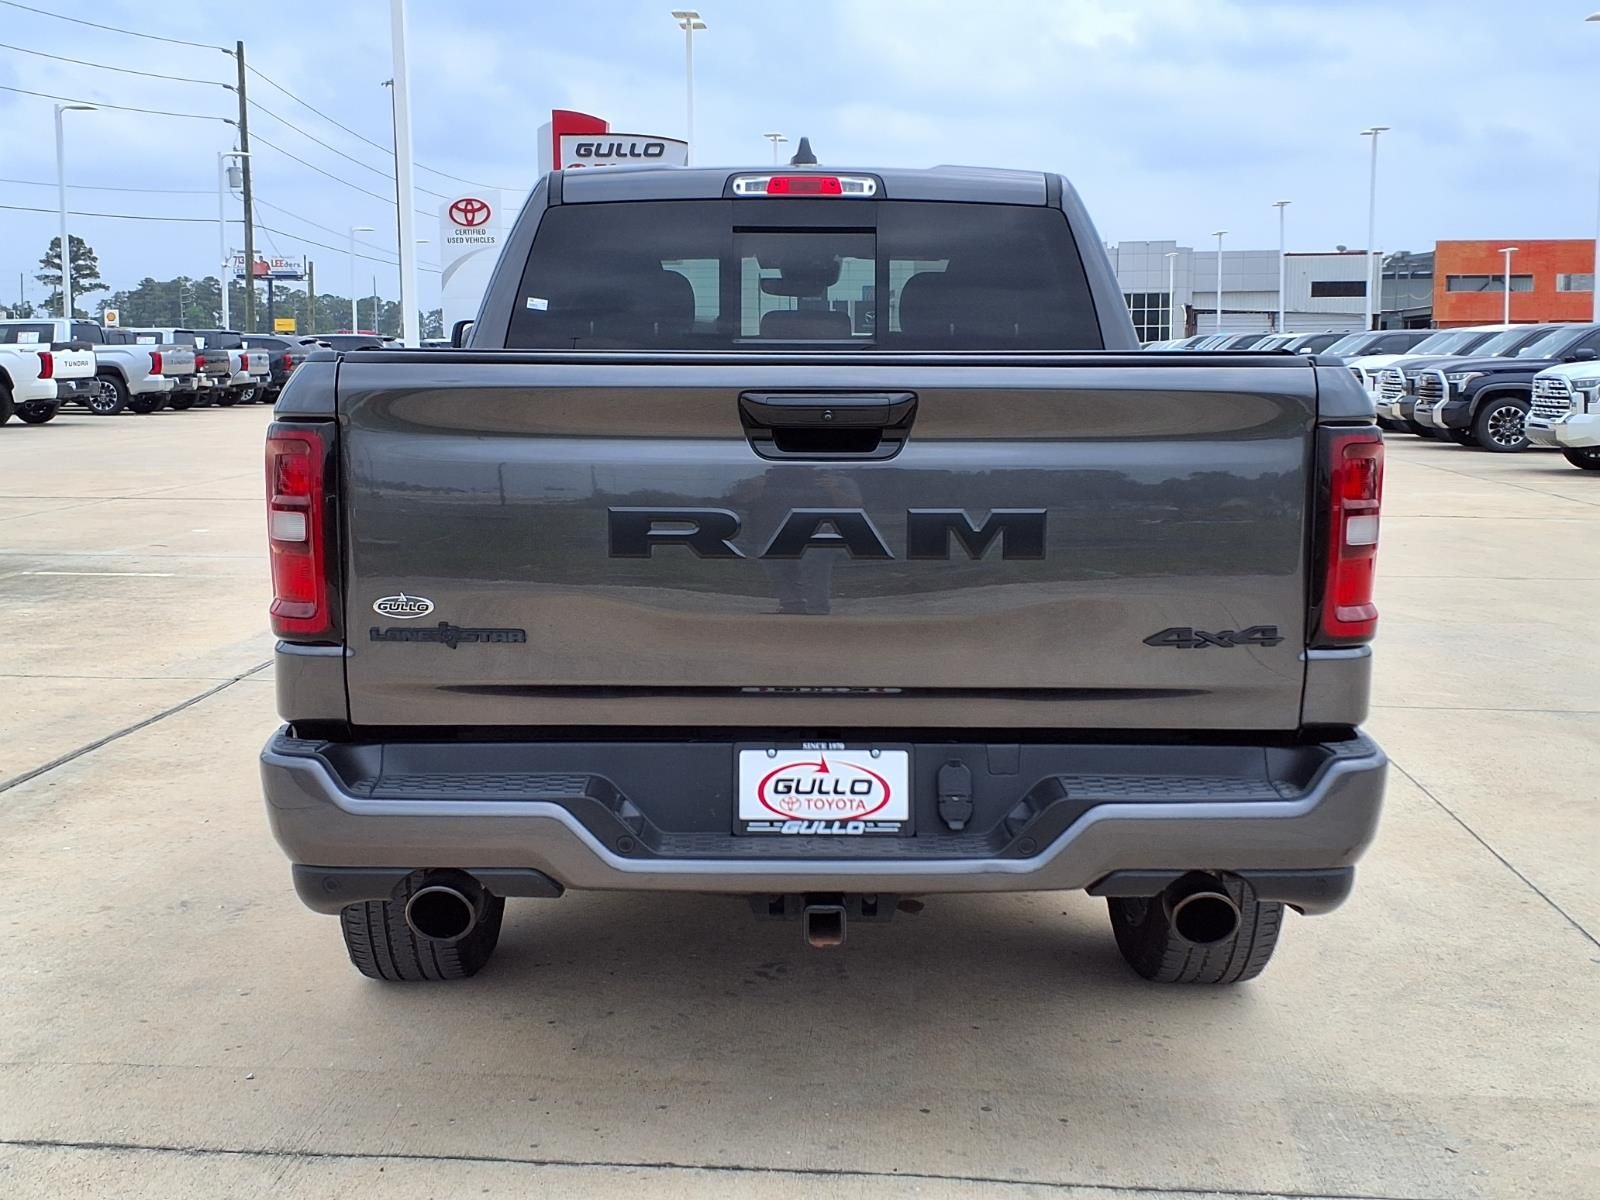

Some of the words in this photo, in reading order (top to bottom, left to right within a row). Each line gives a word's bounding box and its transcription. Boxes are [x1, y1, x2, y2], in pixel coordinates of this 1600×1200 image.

[575, 142, 665, 158] GULLO
[608, 506, 1048, 560] RAM
[377, 602, 430, 612] GULLO
[802, 742, 828, 750] SINCE
[773, 778, 873, 795] GULLO
[805, 799, 867, 811] TOYOTA
[781, 821, 866, 835] GULLO
